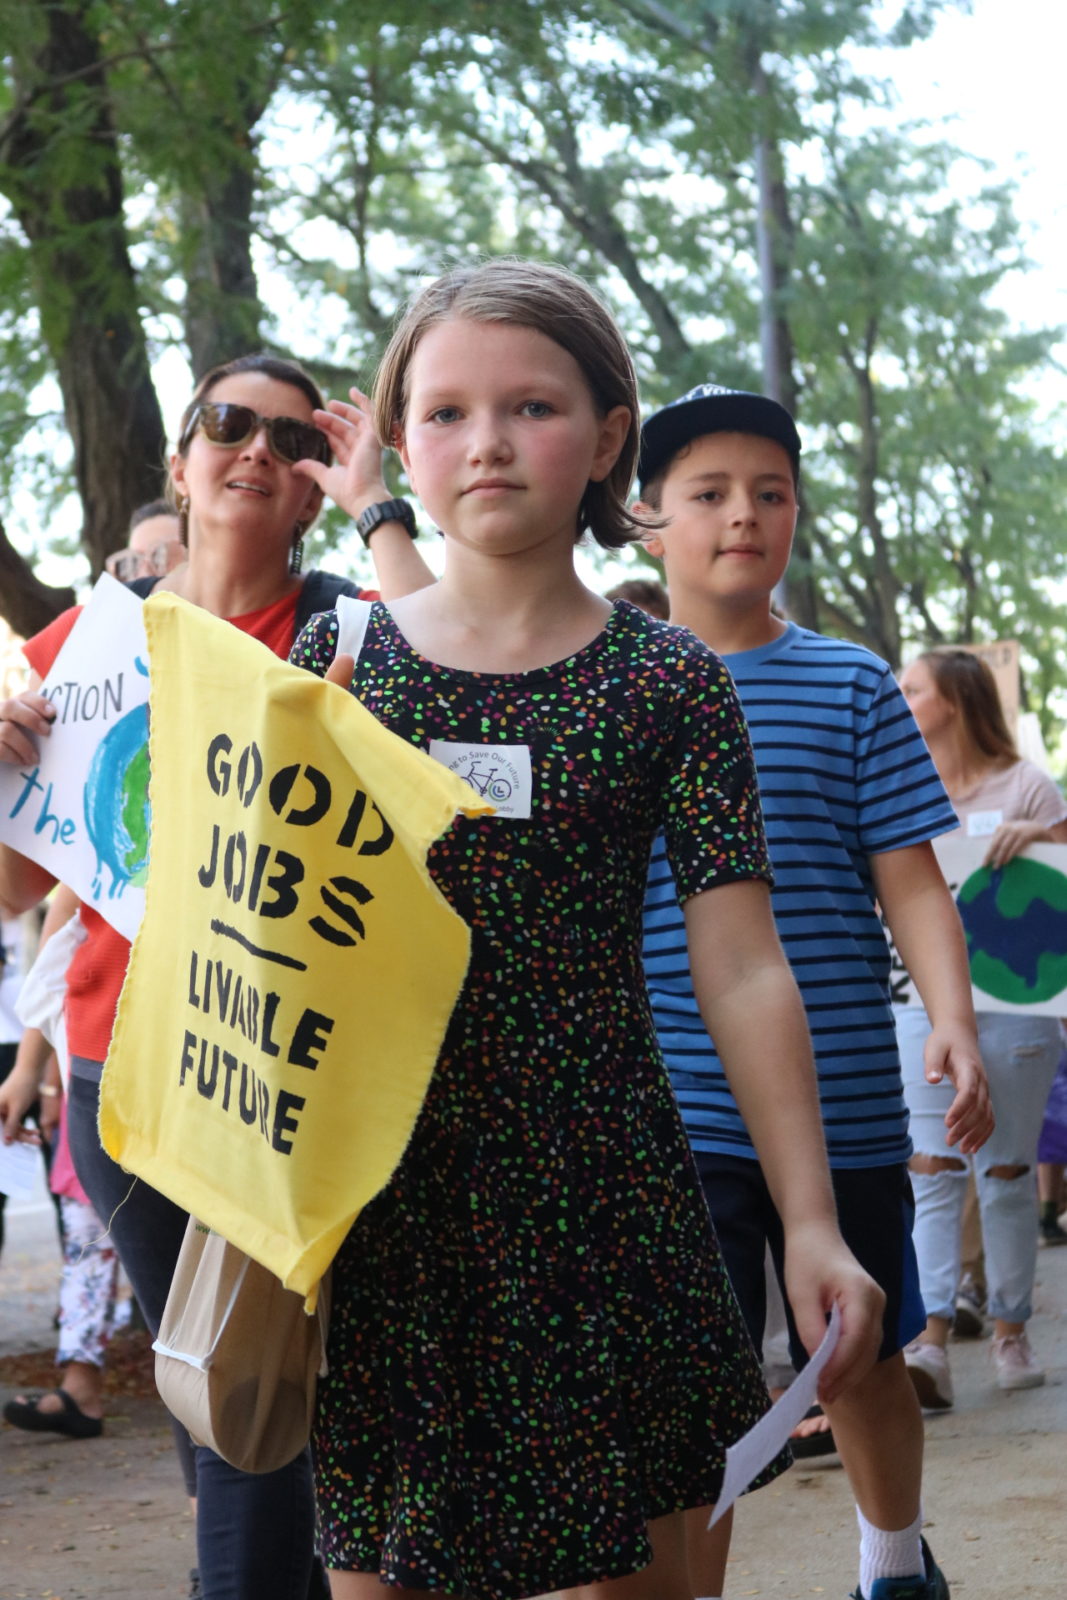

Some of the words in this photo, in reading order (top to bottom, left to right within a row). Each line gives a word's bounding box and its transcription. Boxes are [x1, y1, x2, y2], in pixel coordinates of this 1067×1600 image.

[43, 672, 123, 724] CTION
[9, 767, 76, 845] the
[206, 733, 394, 856] GOOD
[457, 755, 468, 763] to
[469, 751, 490, 759] Save
[491, 752, 507, 764] Our
[505, 762, 519, 790] Future
[197, 824, 375, 947] JOBS
[188, 950, 335, 1071] LIVABLE
[179, 1029, 307, 1156] FUTURE
